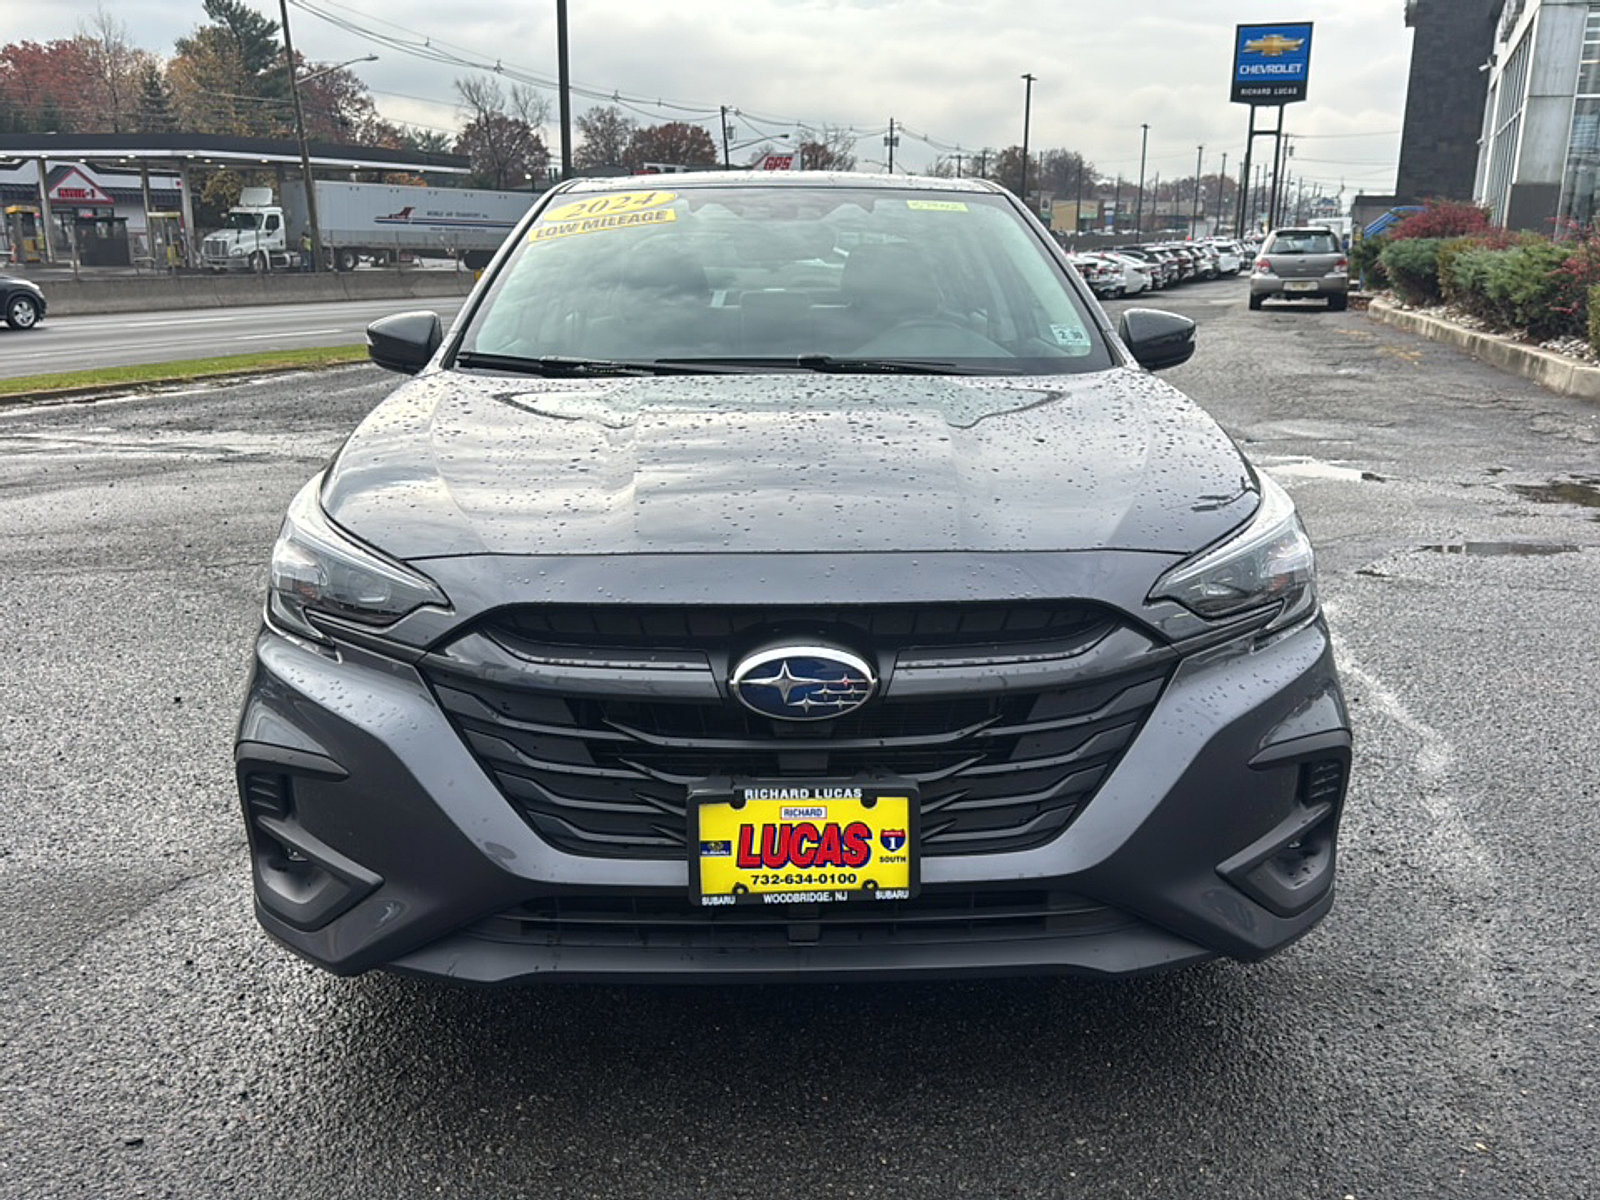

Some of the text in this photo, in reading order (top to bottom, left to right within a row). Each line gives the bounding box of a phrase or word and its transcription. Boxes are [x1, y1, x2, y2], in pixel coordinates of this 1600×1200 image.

[1240, 63, 1303, 75] CHEVROLET
[1241, 87, 1298, 95] RICHARD LUCAS
[565, 191, 657, 218] 2024
[535, 210, 668, 239] LOW MILEAGE
[744, 788, 863, 799] RICHARD LUCAS
[783, 808, 823, 817] RICHARD
[736, 821, 873, 869] LUCAS
[888, 836, 897, 849] 1
[750, 873, 857, 885] 732-634-0100
[835, 891, 848, 902] NJ
[875, 890, 909, 900] SUBARU
[701, 896, 736, 906] SUBARU
